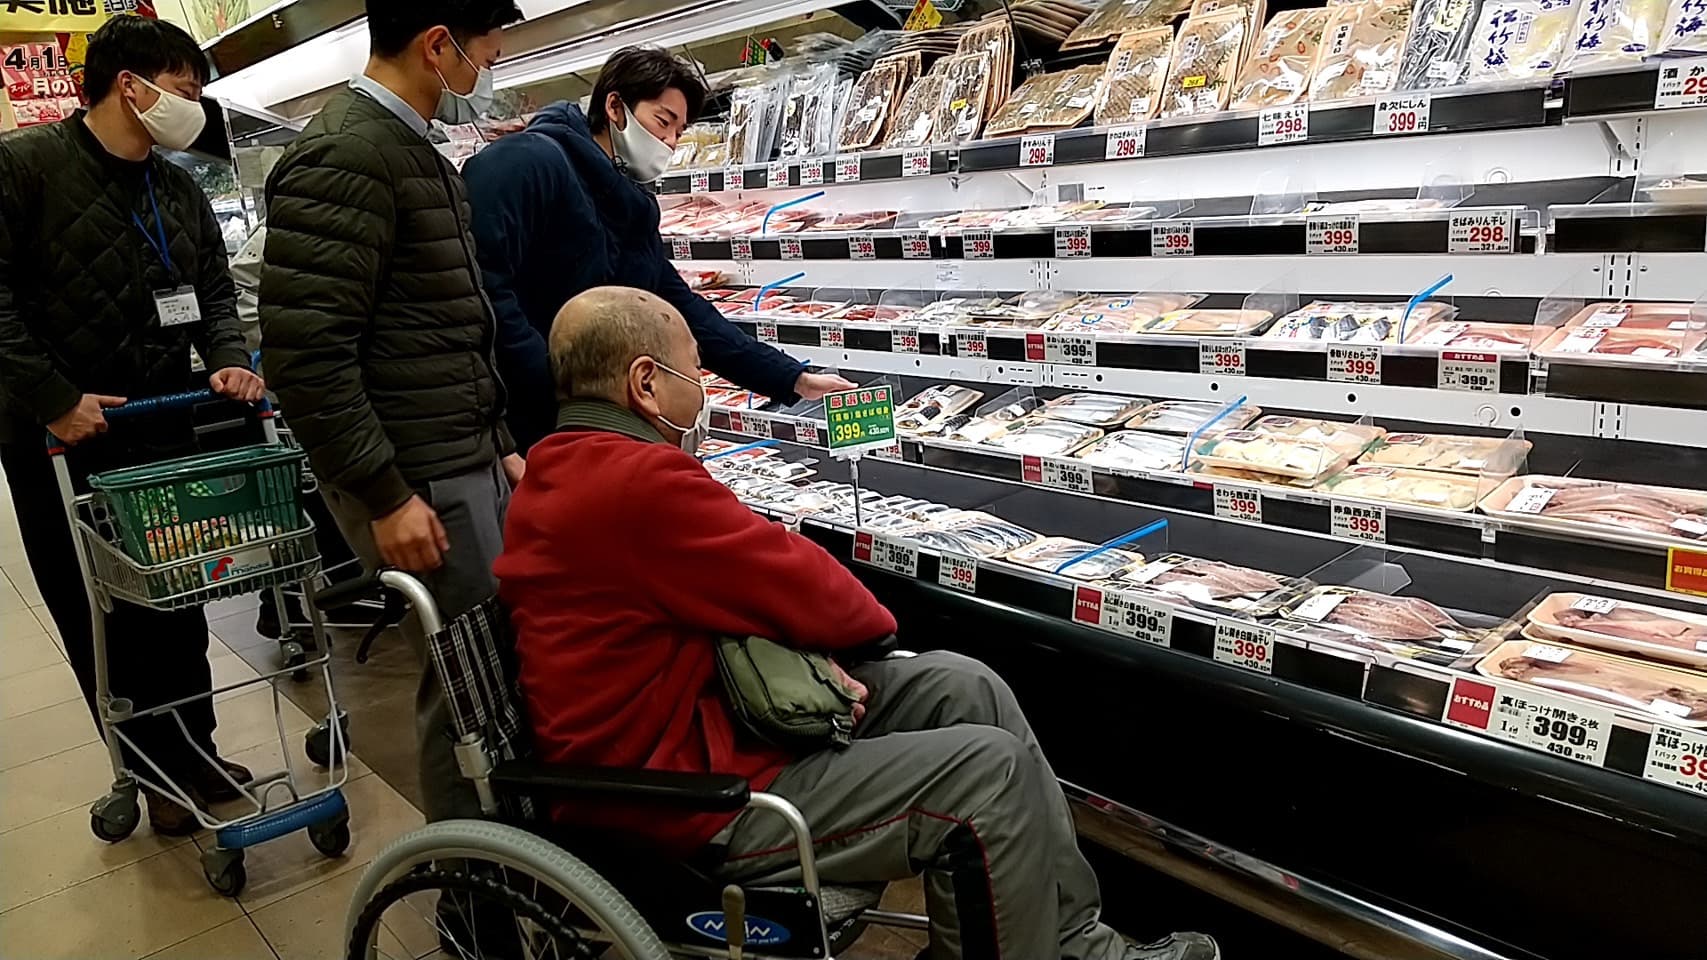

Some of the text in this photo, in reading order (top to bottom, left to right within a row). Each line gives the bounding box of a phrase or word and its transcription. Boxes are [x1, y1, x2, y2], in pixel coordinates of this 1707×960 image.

[1378, 99, 1427, 111] 身欠にしん
[1262, 109, 1305, 122] 七味えい
[1388, 112, 1416, 132] 399
[1275, 118, 1302, 134] 298
[1029, 147, 1046, 164] 298
[1116, 139, 1136, 157] 298
[1452, 216, 1506, 227] さばみりん干し
[1166, 234, 1189, 248] 399
[1323, 230, 1353, 245] 399
[1469, 226, 1503, 242] 298
[911, 241, 927, 252] 399
[973, 241, 990, 252] 399
[1067, 238, 1087, 250] 399
[828, 332, 841, 342] 399
[901, 336, 916, 347] 399
[967, 341, 984, 352] 399
[1215, 353, 1240, 367] 399
[1345, 359, 1375, 375] 399
[1230, 498, 1256, 514] 399
[1349, 516, 1380, 534] 399
[951, 566, 972, 583] 399
[1233, 640, 1266, 662] 399
[1453, 694, 1489, 711] おすすめ品
